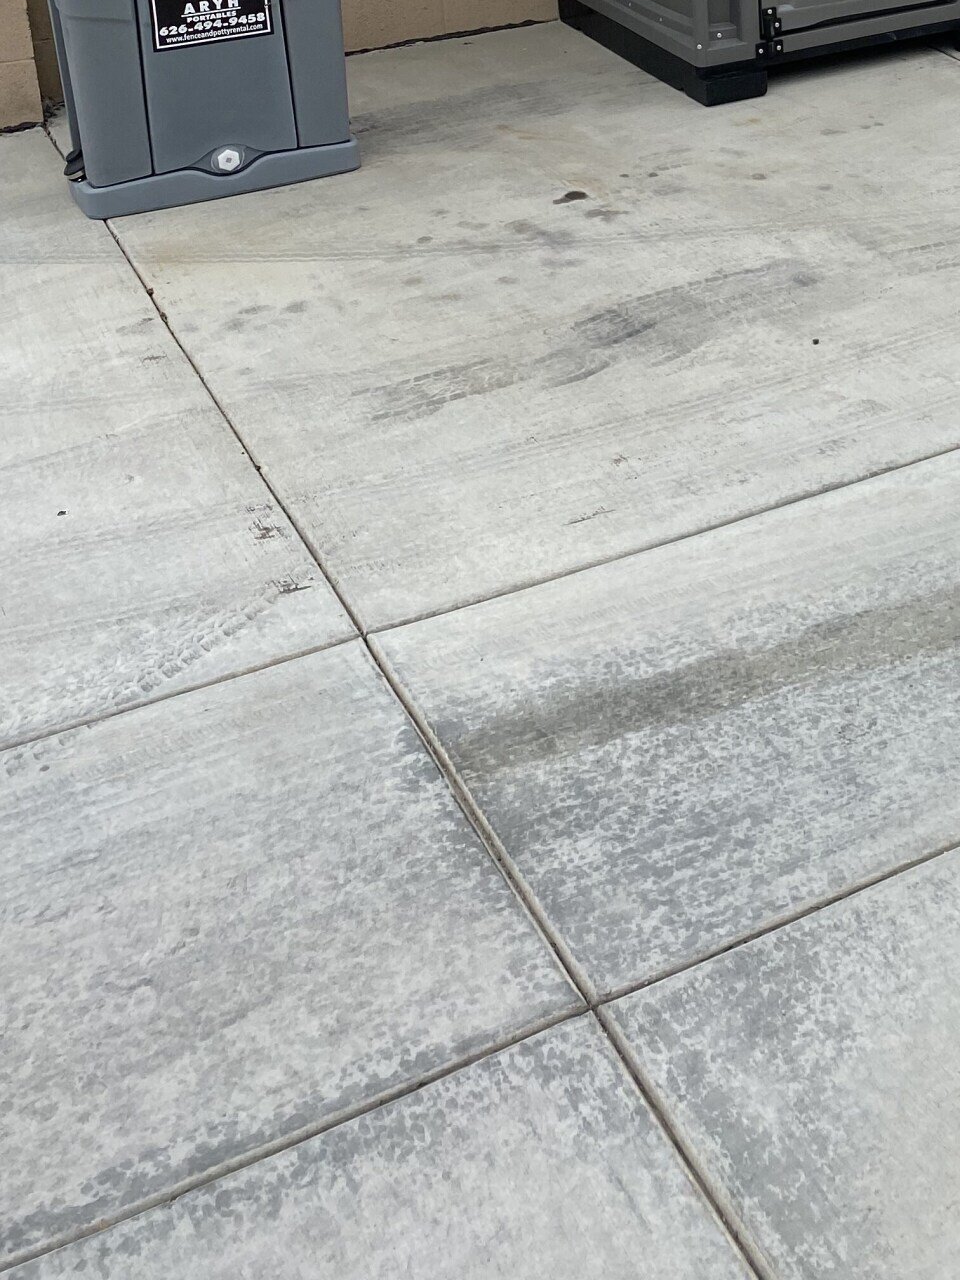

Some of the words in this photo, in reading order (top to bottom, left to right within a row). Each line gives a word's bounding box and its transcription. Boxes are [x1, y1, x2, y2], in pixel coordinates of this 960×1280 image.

[159, 12, 266, 37] 626-494-9458
[186, 10, 237, 23] PORTABLES
[166, 23, 263, 43] www.fenceandpottyrental.com
